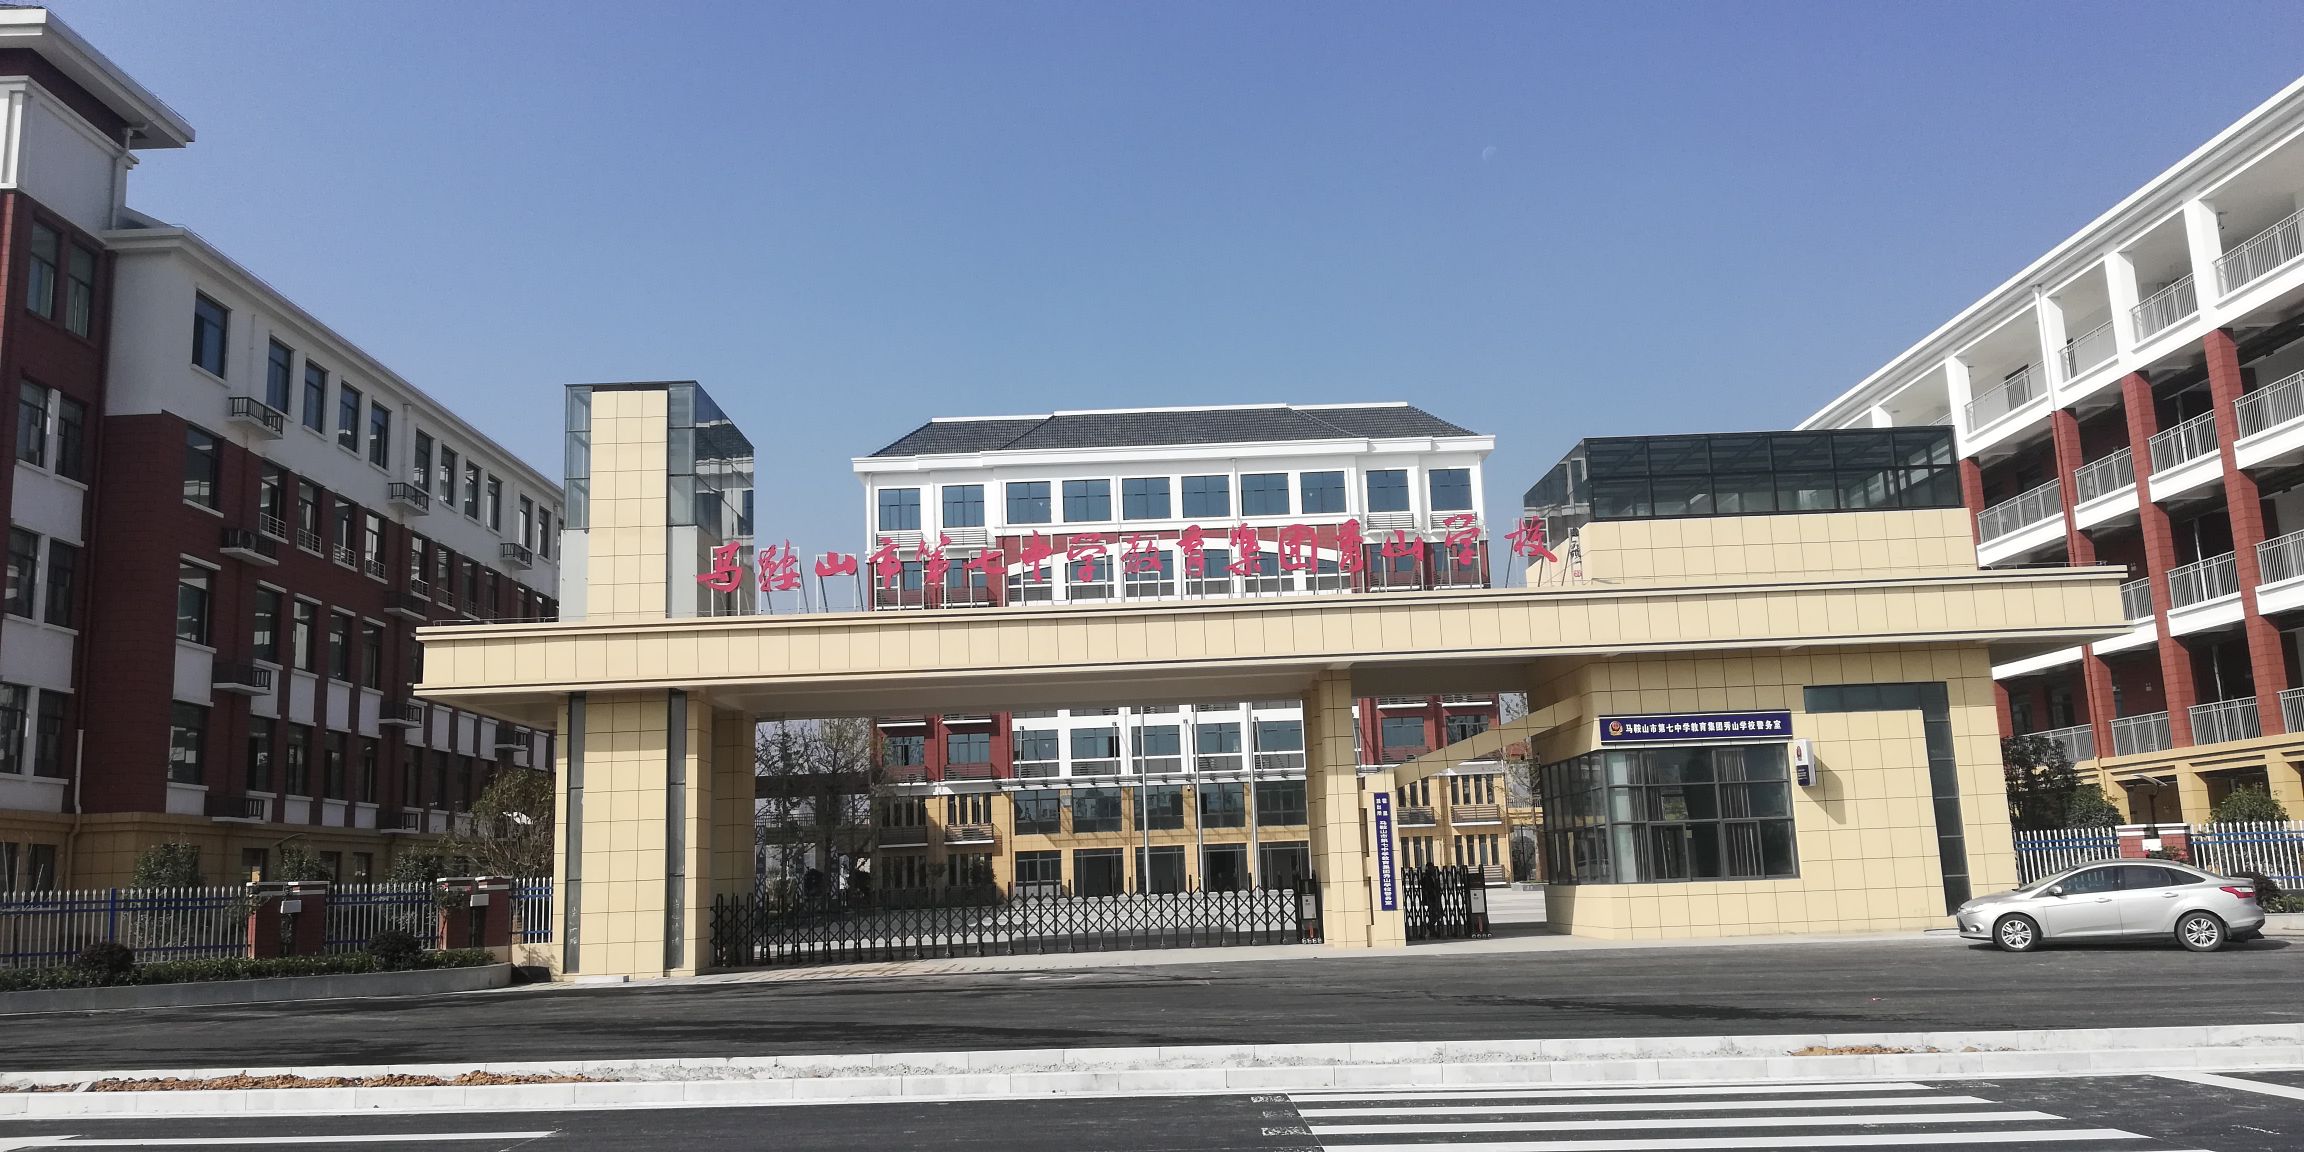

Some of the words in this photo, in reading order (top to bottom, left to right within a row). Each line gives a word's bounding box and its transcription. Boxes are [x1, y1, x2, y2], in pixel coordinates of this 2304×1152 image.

[1625, 719, 1782, 734] 马鞍山市第七中学教育集团秀山学校警务室
